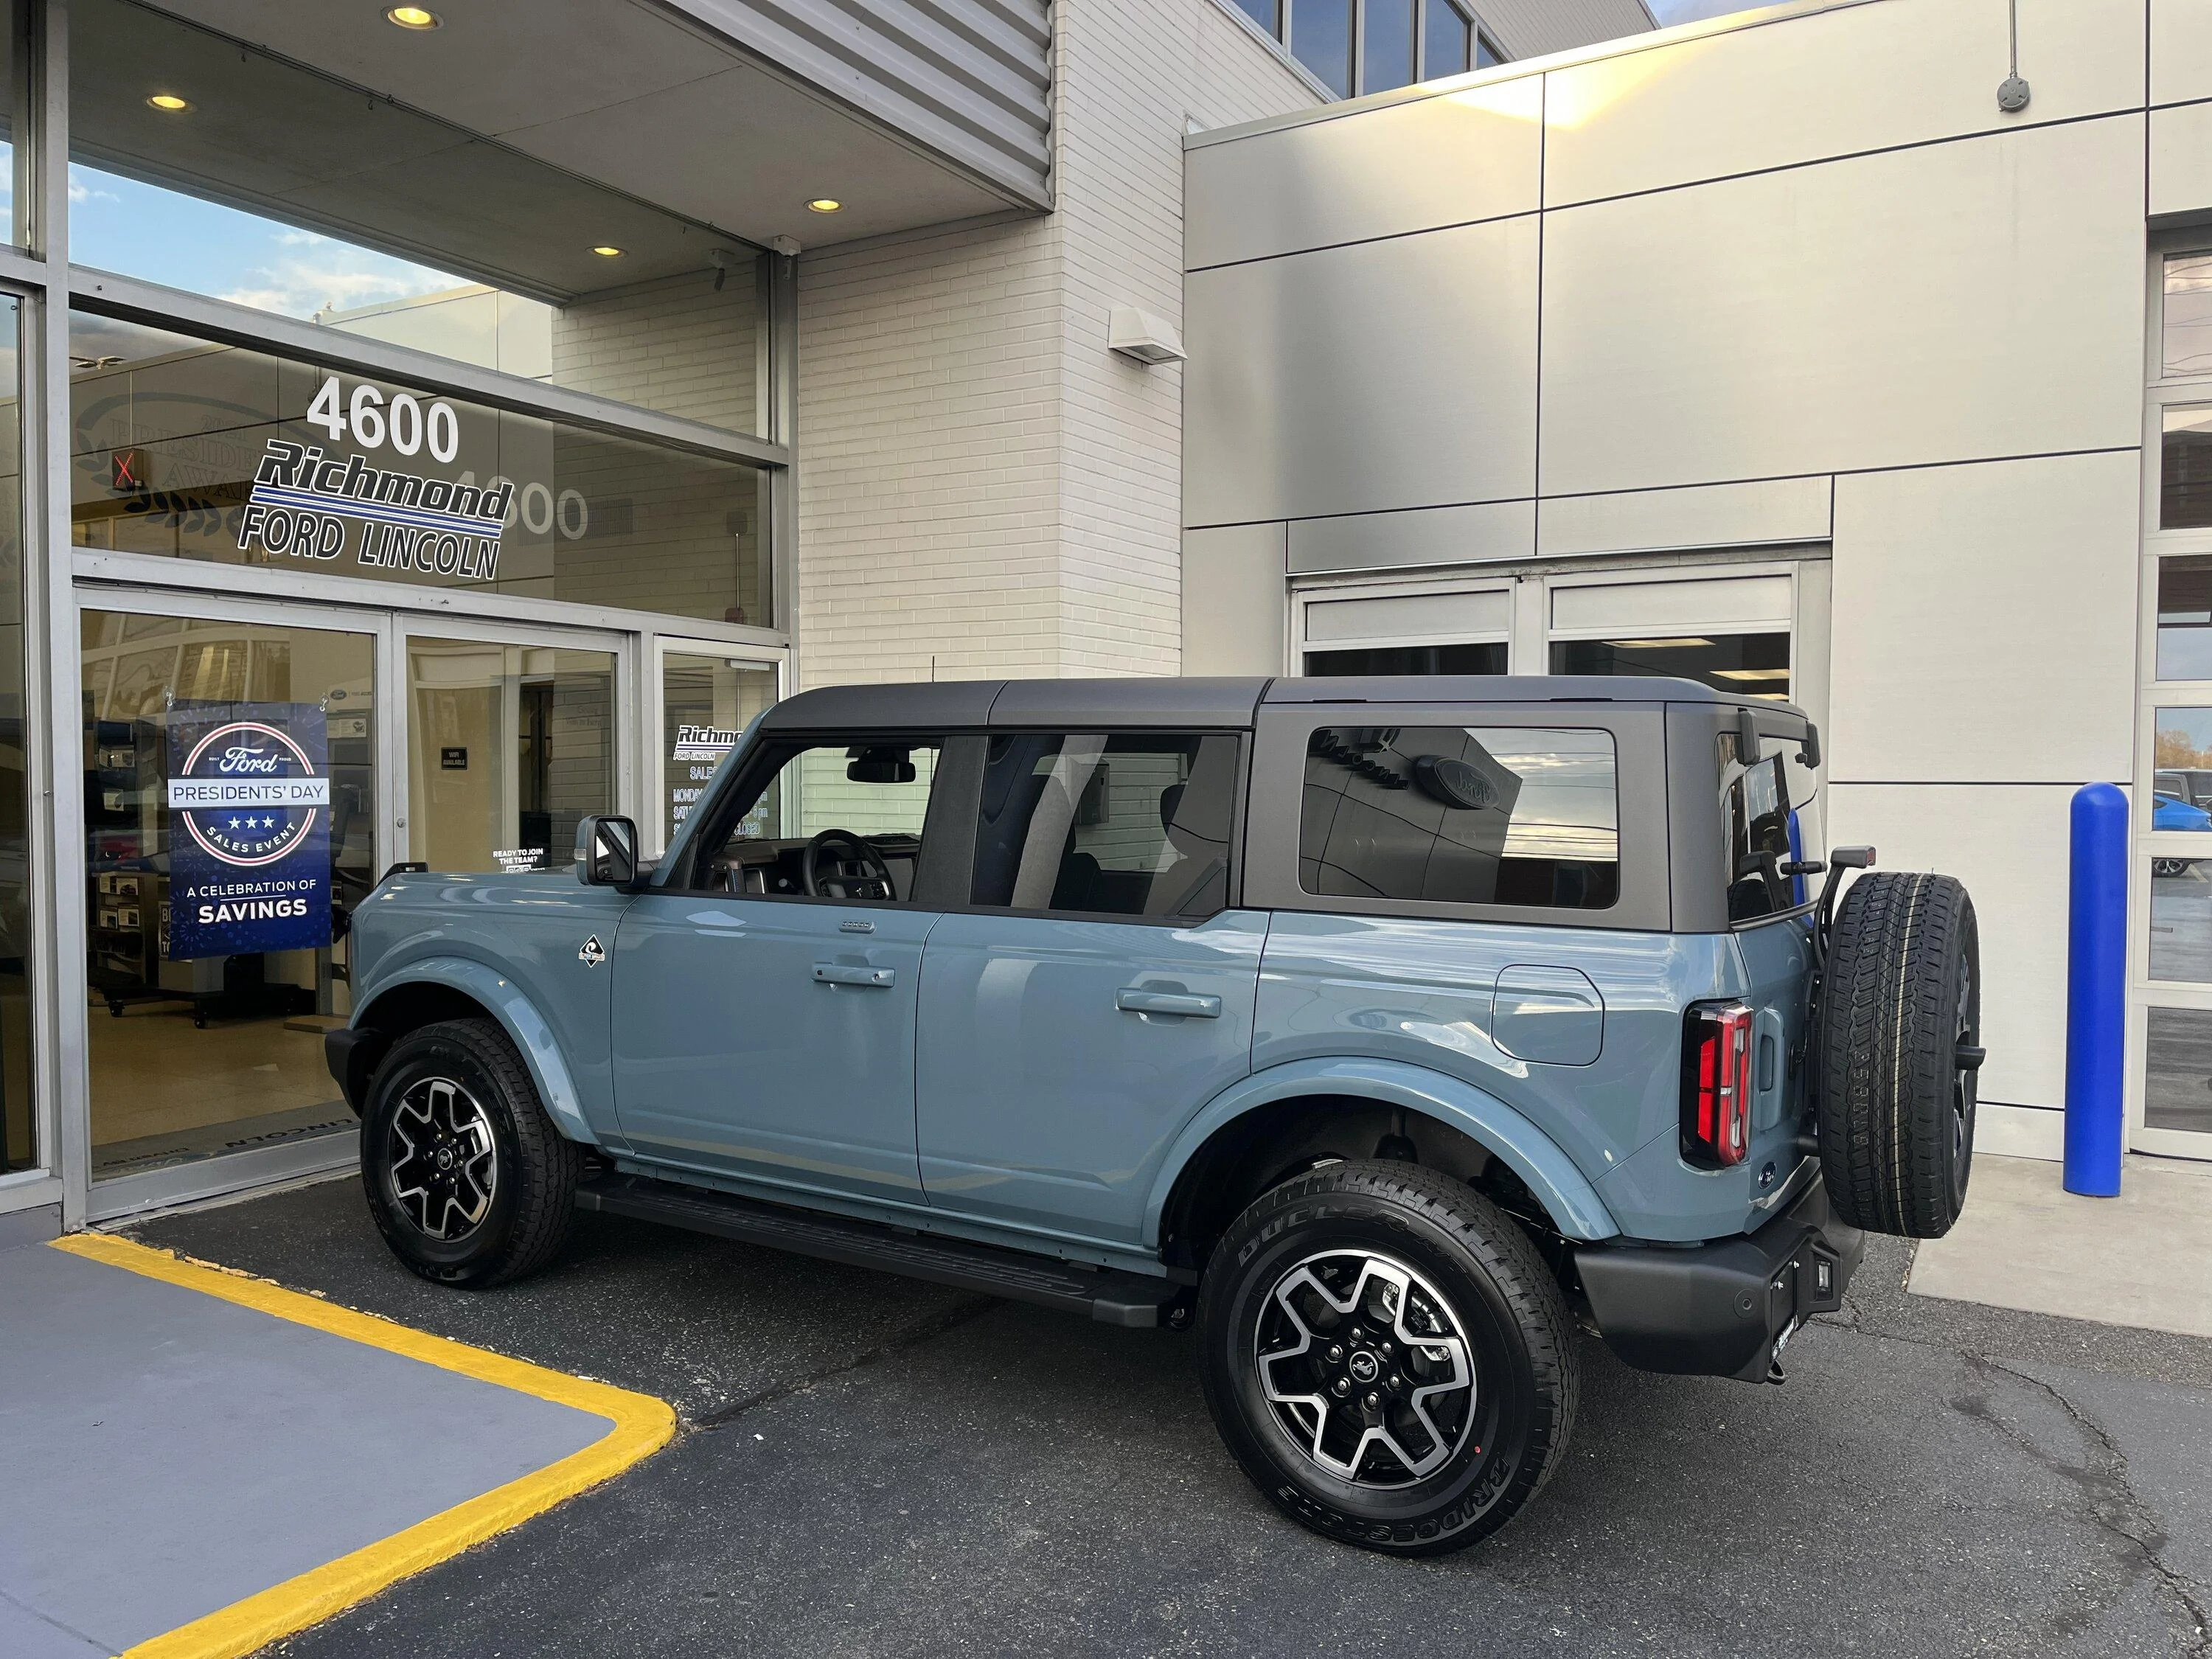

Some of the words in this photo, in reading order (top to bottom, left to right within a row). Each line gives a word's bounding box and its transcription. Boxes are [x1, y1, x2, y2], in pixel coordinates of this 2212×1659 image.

[306, 376, 459, 463] 4600
[254, 438, 515, 521] Richmond
[237, 505, 345, 560] FORD
[358, 521, 501, 580] LINCOLN
[219, 746, 278, 773] Ford
[673, 752, 691, 760] FORD
[690, 752, 715, 760] LINCOLN
[291, 785, 324, 799] DAY
[206, 826, 248, 853] SALES
[256, 821, 295, 852] EVENT
[493, 849, 517, 858] READY
[514, 855, 538, 863] TEAM?
[187, 886, 196, 897] A
[199, 880, 296, 897] CELEBRATION
[298, 878, 316, 889] OF
[198, 898, 307, 923] SAVINGS
